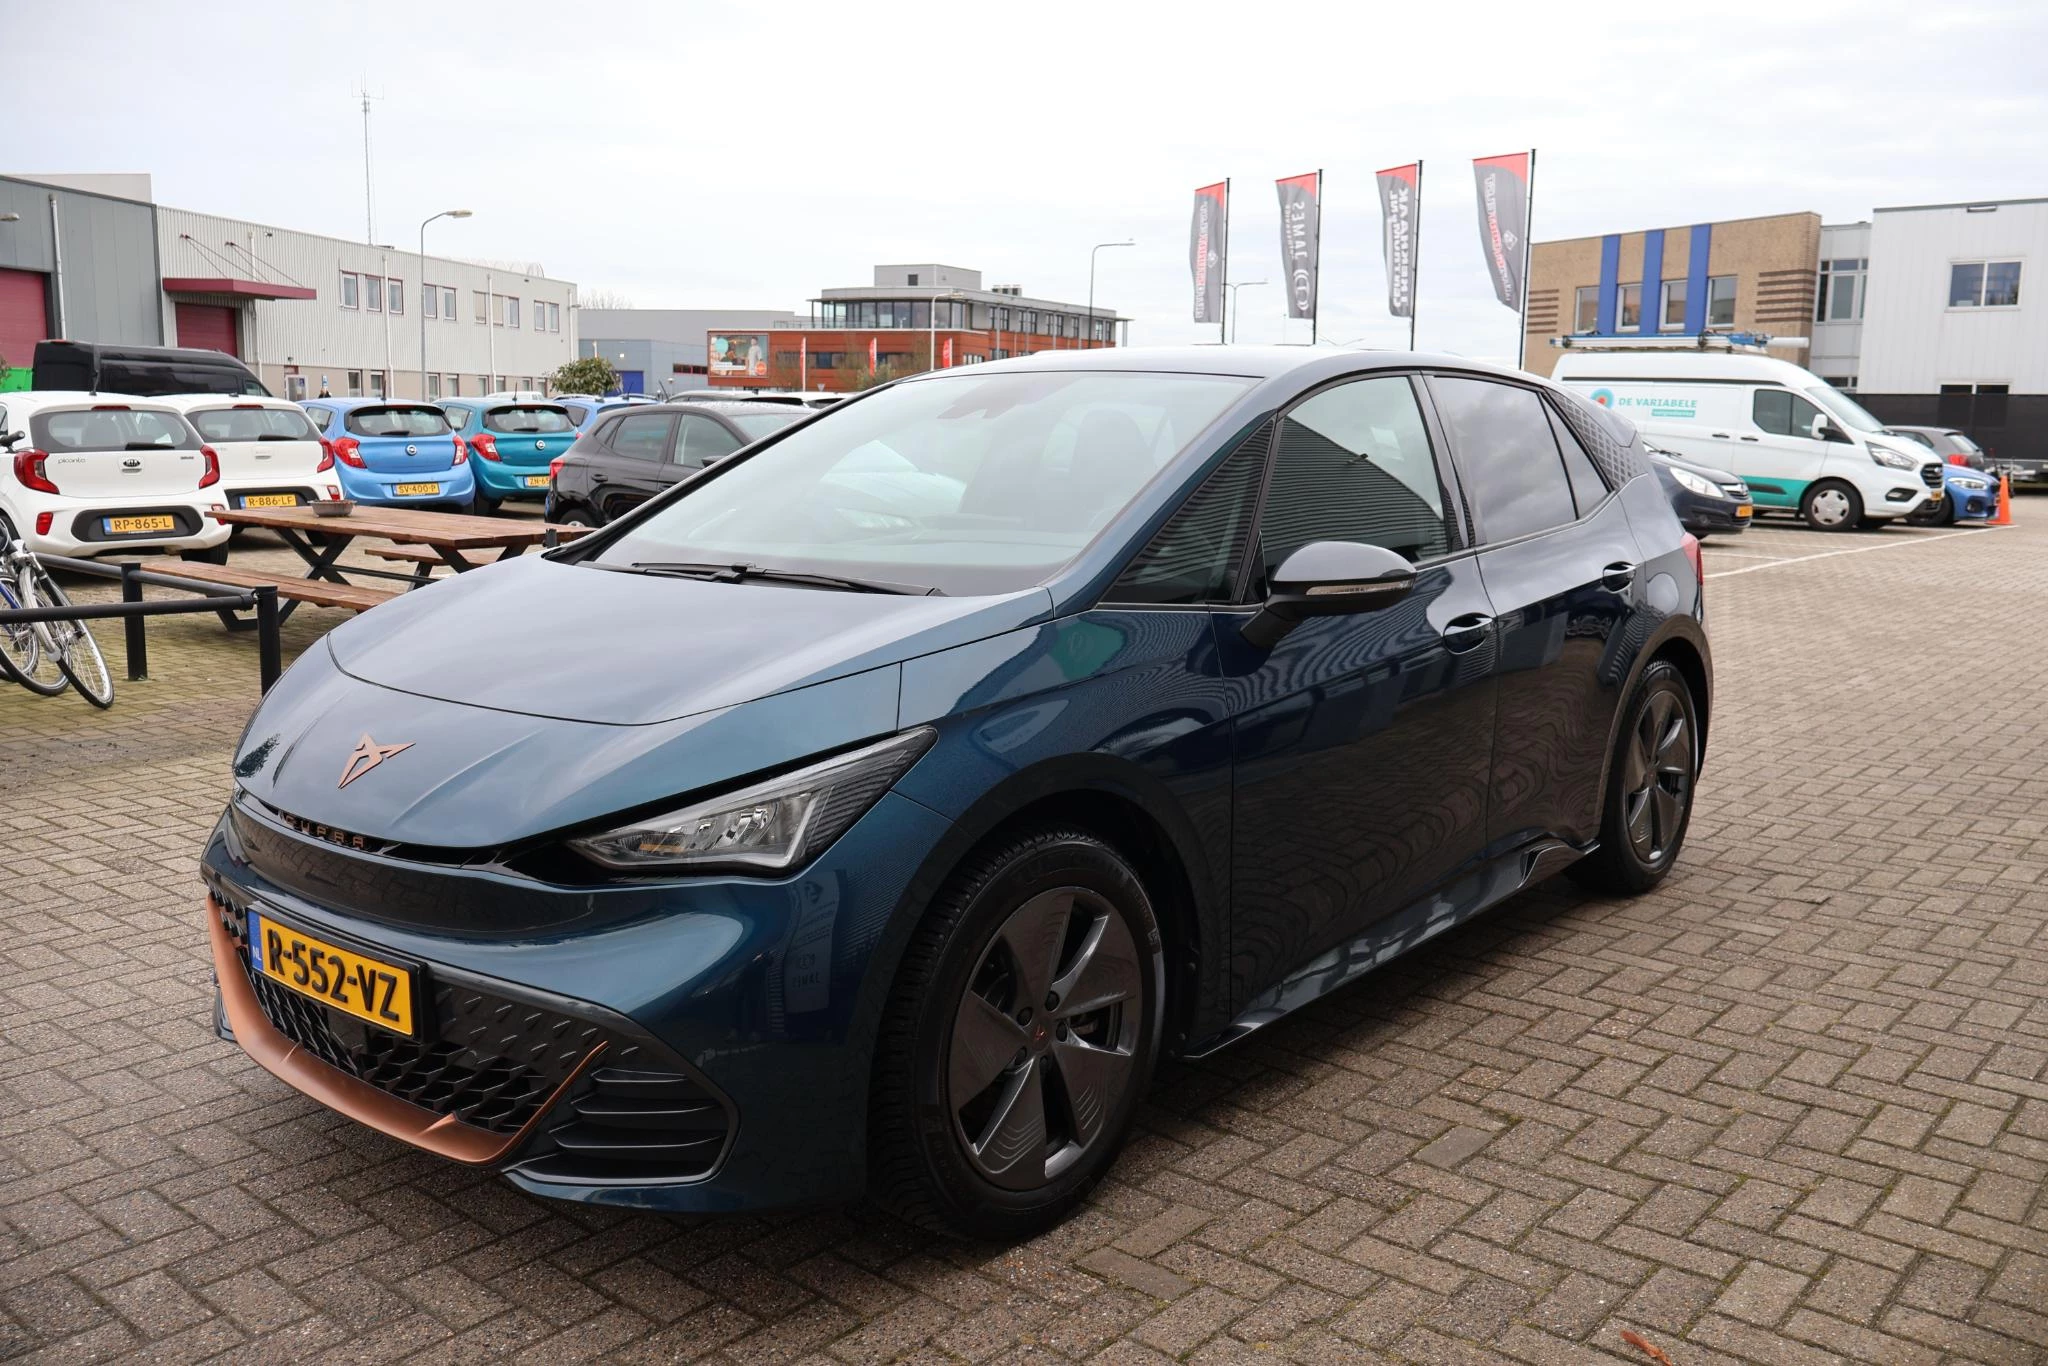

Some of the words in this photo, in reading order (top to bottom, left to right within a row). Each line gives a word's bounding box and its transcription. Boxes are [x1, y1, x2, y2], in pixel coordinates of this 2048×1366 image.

[1618, 397, 1632, 406] DE
[1636, 397, 1697, 408] VARIABELE
[399, 484, 436, 493] SV-400-P
[248, 496, 292, 506] R-886-LF
[114, 518, 170, 530] RP-865-L
[284, 814, 364, 848] CUPRA
[252, 946, 262, 961] NL
[267, 928, 400, 1022] R-552-VZ
